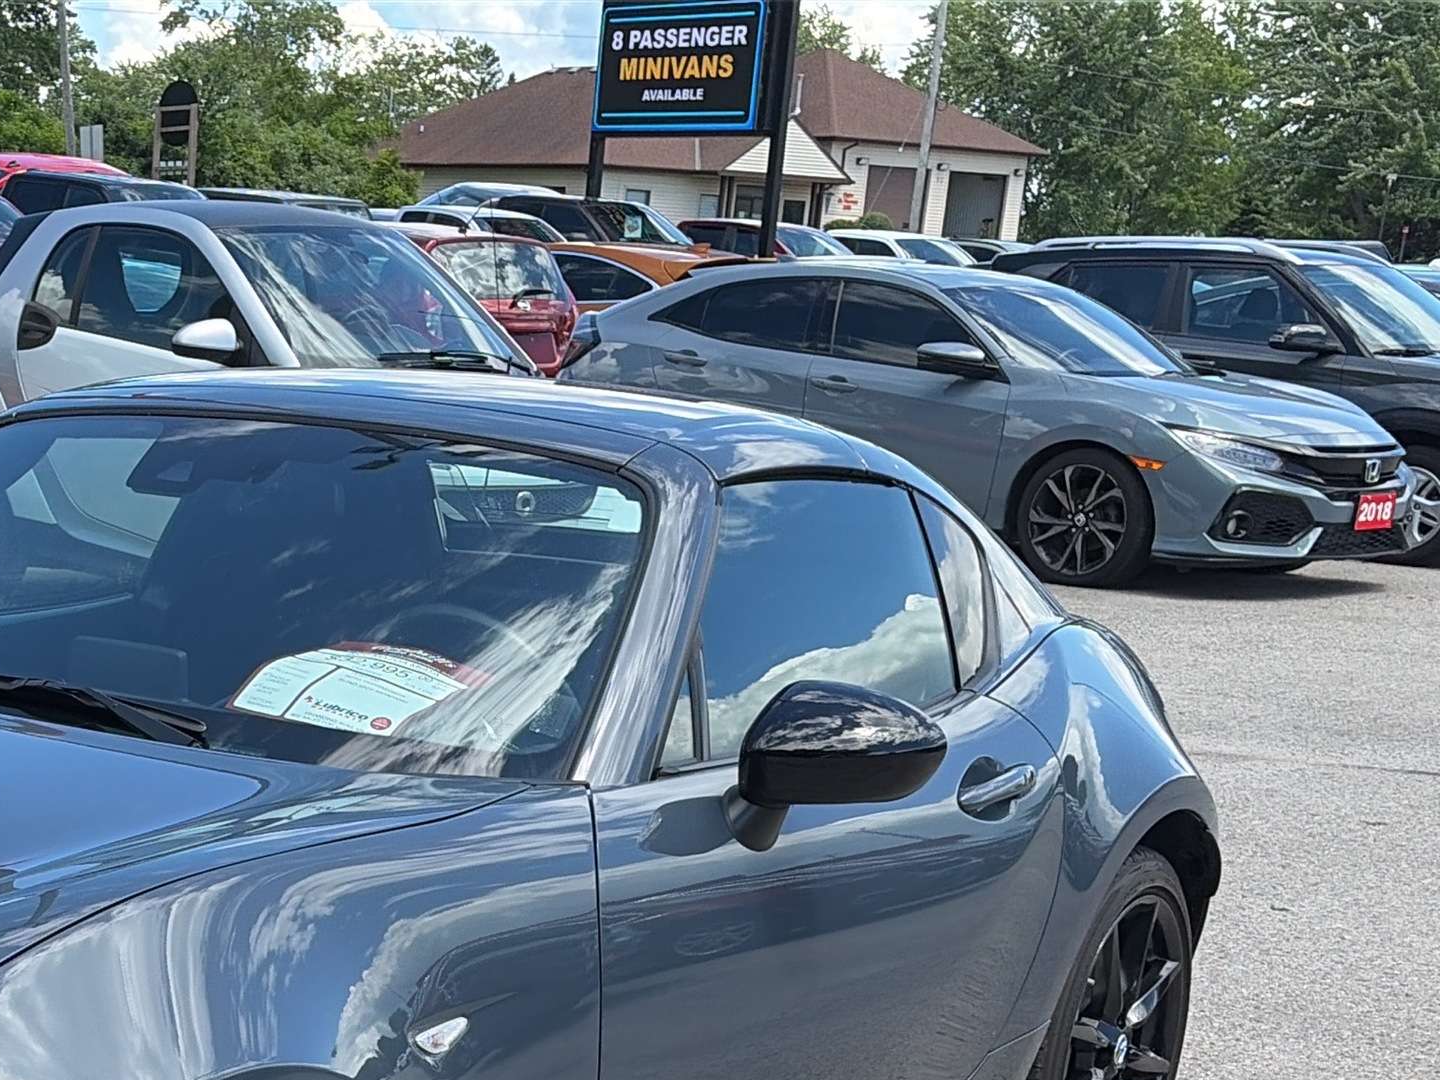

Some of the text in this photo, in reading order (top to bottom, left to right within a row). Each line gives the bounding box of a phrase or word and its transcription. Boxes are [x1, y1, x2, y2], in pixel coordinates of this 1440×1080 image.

[612, 25, 748, 50] 8 PASSENGER
[619, 54, 734, 81] MINIVANS
[641, 88, 704, 101] AVAILABLE
[1358, 501, 1393, 522] 2018
